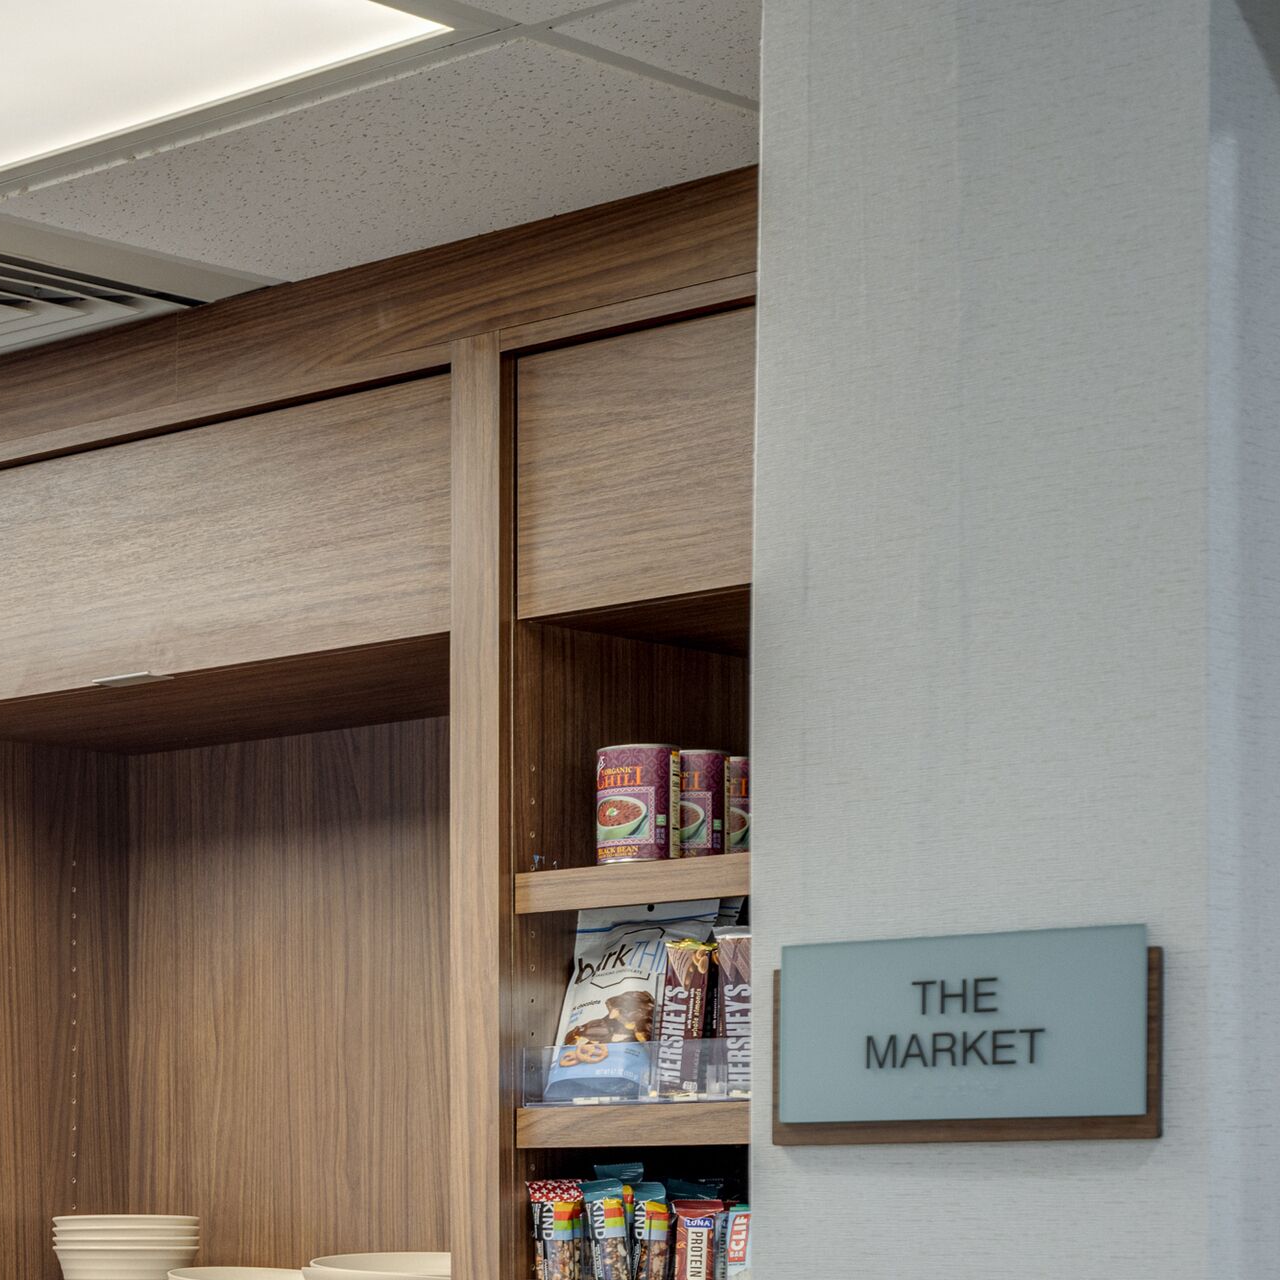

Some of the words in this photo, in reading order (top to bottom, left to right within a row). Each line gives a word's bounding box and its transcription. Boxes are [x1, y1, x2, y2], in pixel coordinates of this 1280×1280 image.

[604, 766, 632, 776] ORGANIC
[912, 977, 998, 1015] THE
[657, 985, 689, 1083] HERSHEY'S
[724, 984, 752, 1084] HERSHEY'S
[865, 1028, 1045, 1070] MARKET
[542, 1201, 555, 1240] KIND
[593, 1199, 606, 1240] KIND
[634, 1200, 646, 1240] KIND
[686, 1218, 711, 1227] LUNA
[733, 1216, 748, 1249] CLIF
[690, 1230, 703, 1279] PROTEIN
[729, 1250, 744, 1258] BAR
